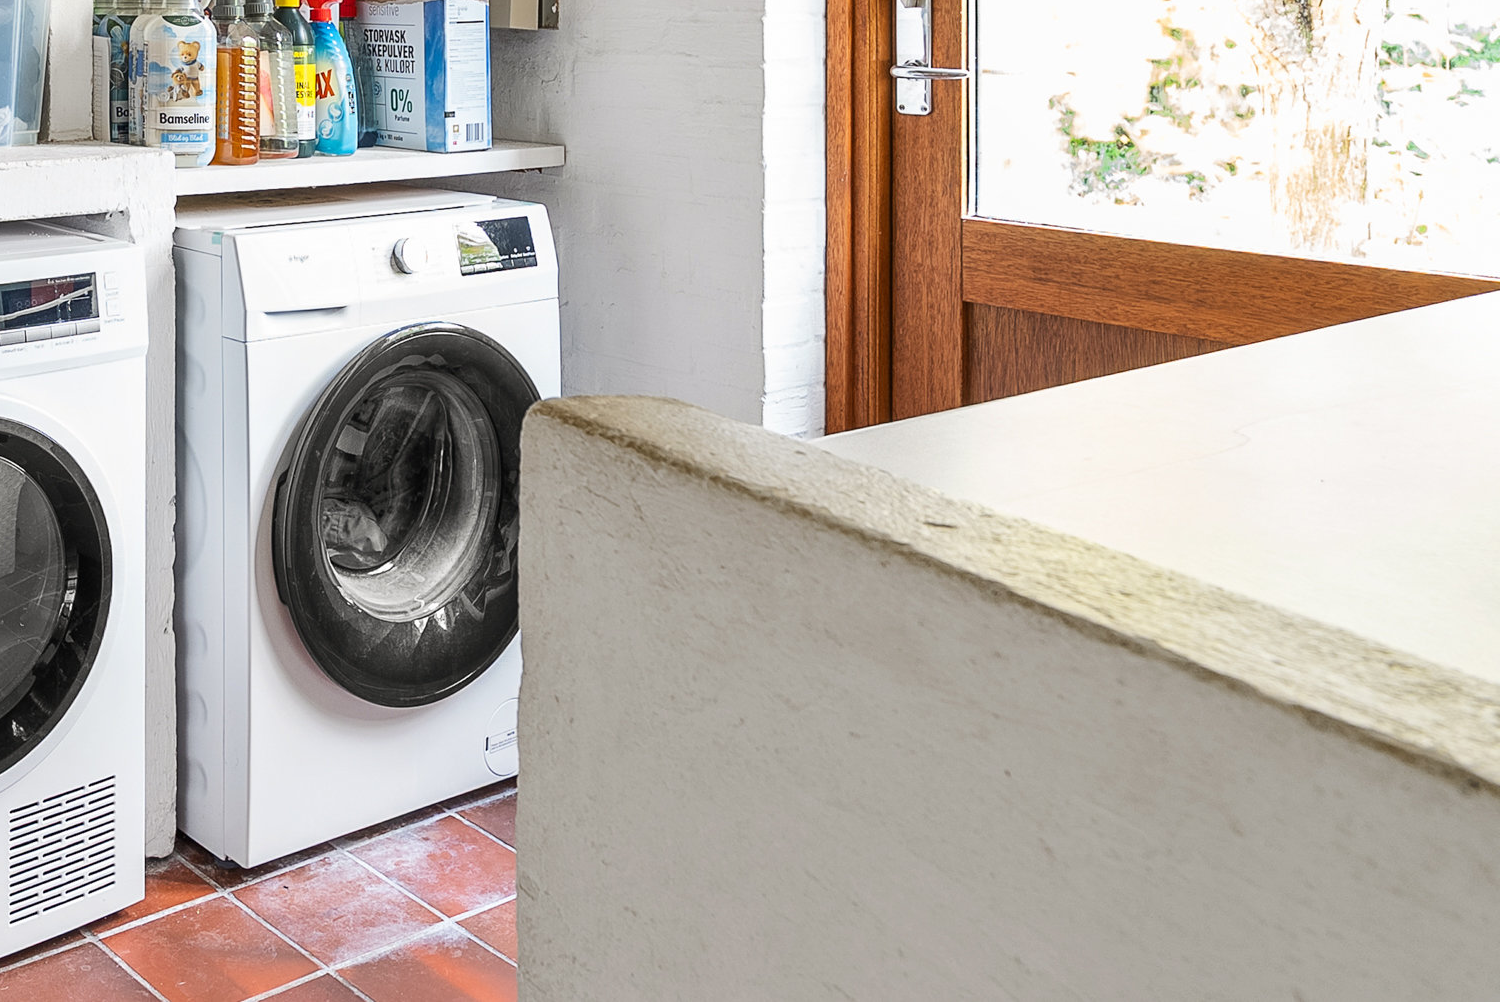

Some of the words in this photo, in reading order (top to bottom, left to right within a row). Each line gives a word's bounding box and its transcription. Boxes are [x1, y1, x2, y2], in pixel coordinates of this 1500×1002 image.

[363, 28, 407, 44] STORVASK
[384, 60, 415, 74] KULØRT
[390, 88, 414, 113] 0%
[159, 112, 210, 125] Bamseline
